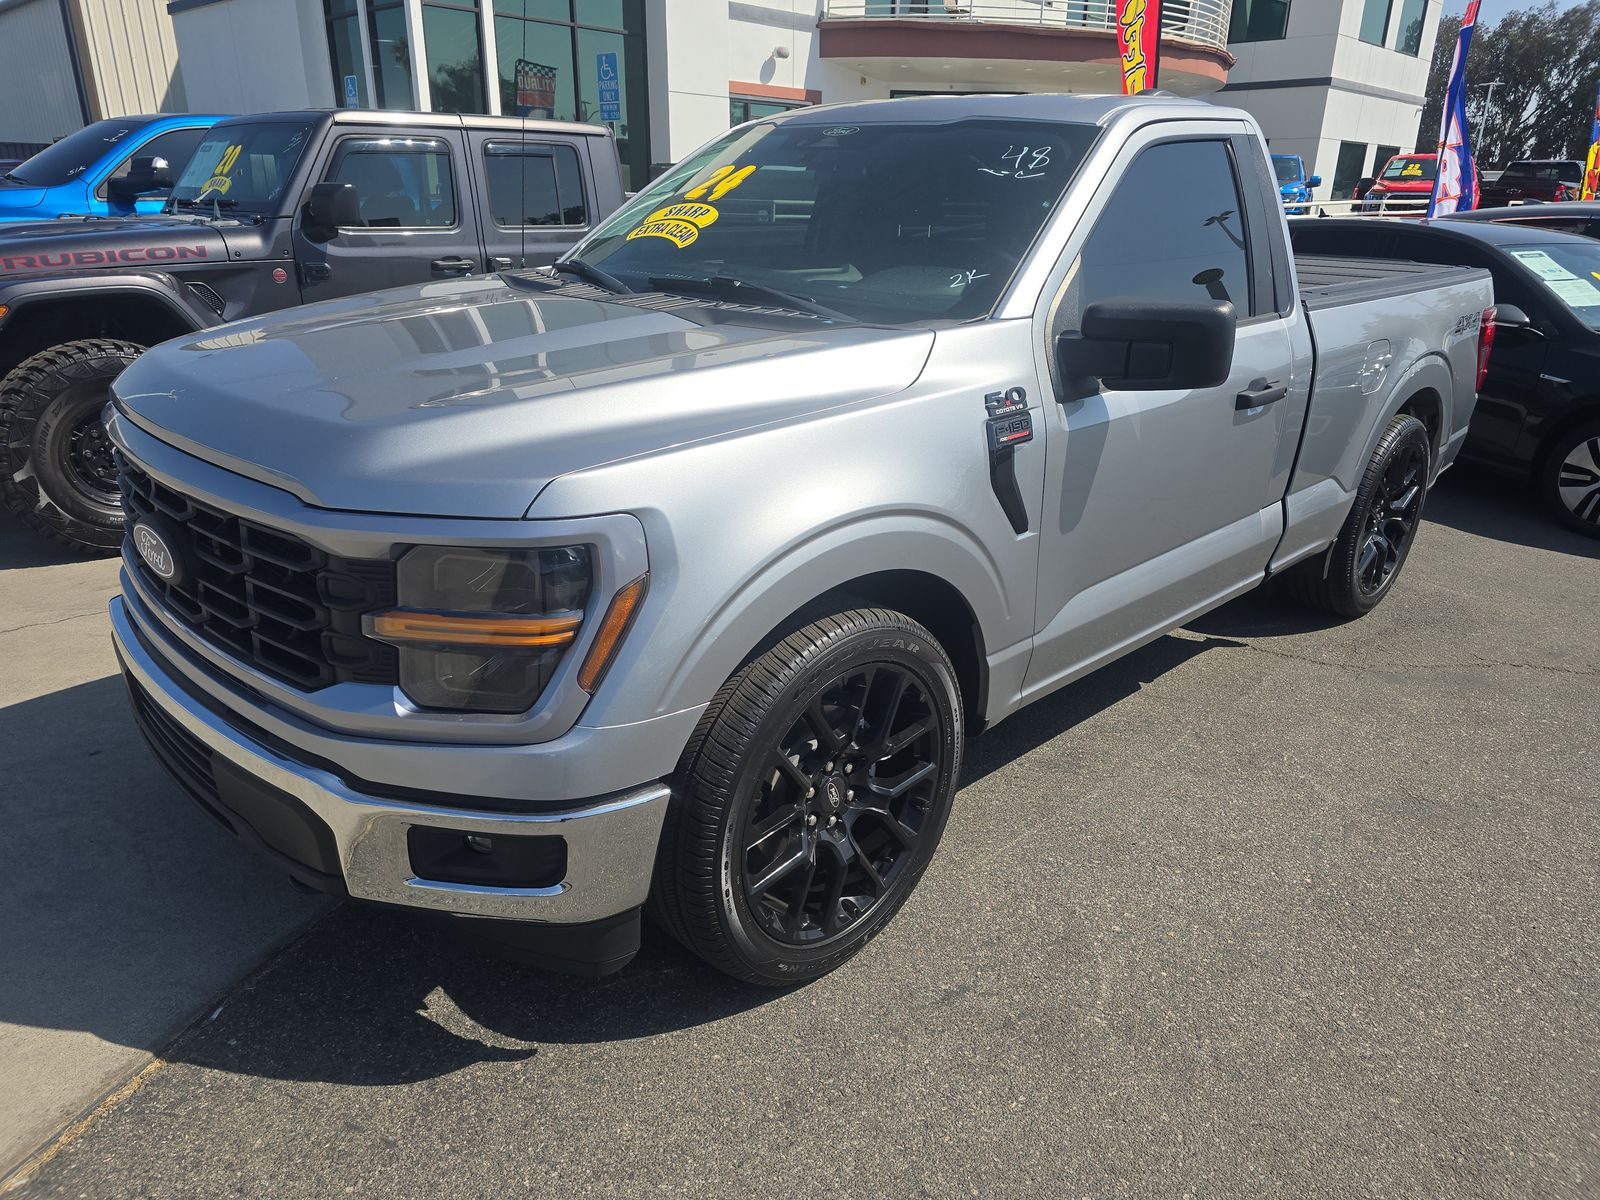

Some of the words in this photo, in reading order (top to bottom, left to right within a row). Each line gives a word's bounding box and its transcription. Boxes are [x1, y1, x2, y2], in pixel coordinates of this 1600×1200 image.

[517, 75, 556, 92] QUALITY
[599, 80, 619, 90] PARKING
[602, 91, 616, 102] ONLY
[214, 144, 242, 175] 20
[1001, 145, 1052, 170] 48
[683, 164, 757, 202] 24
[663, 205, 711, 218] SHARP
[634, 222, 671, 237] EXTRA
[665, 223, 697, 244] CLEAN
[1, 245, 208, 272] RUBICON
[984, 386, 1027, 409] 5.0
[141, 530, 166, 571] Ford
